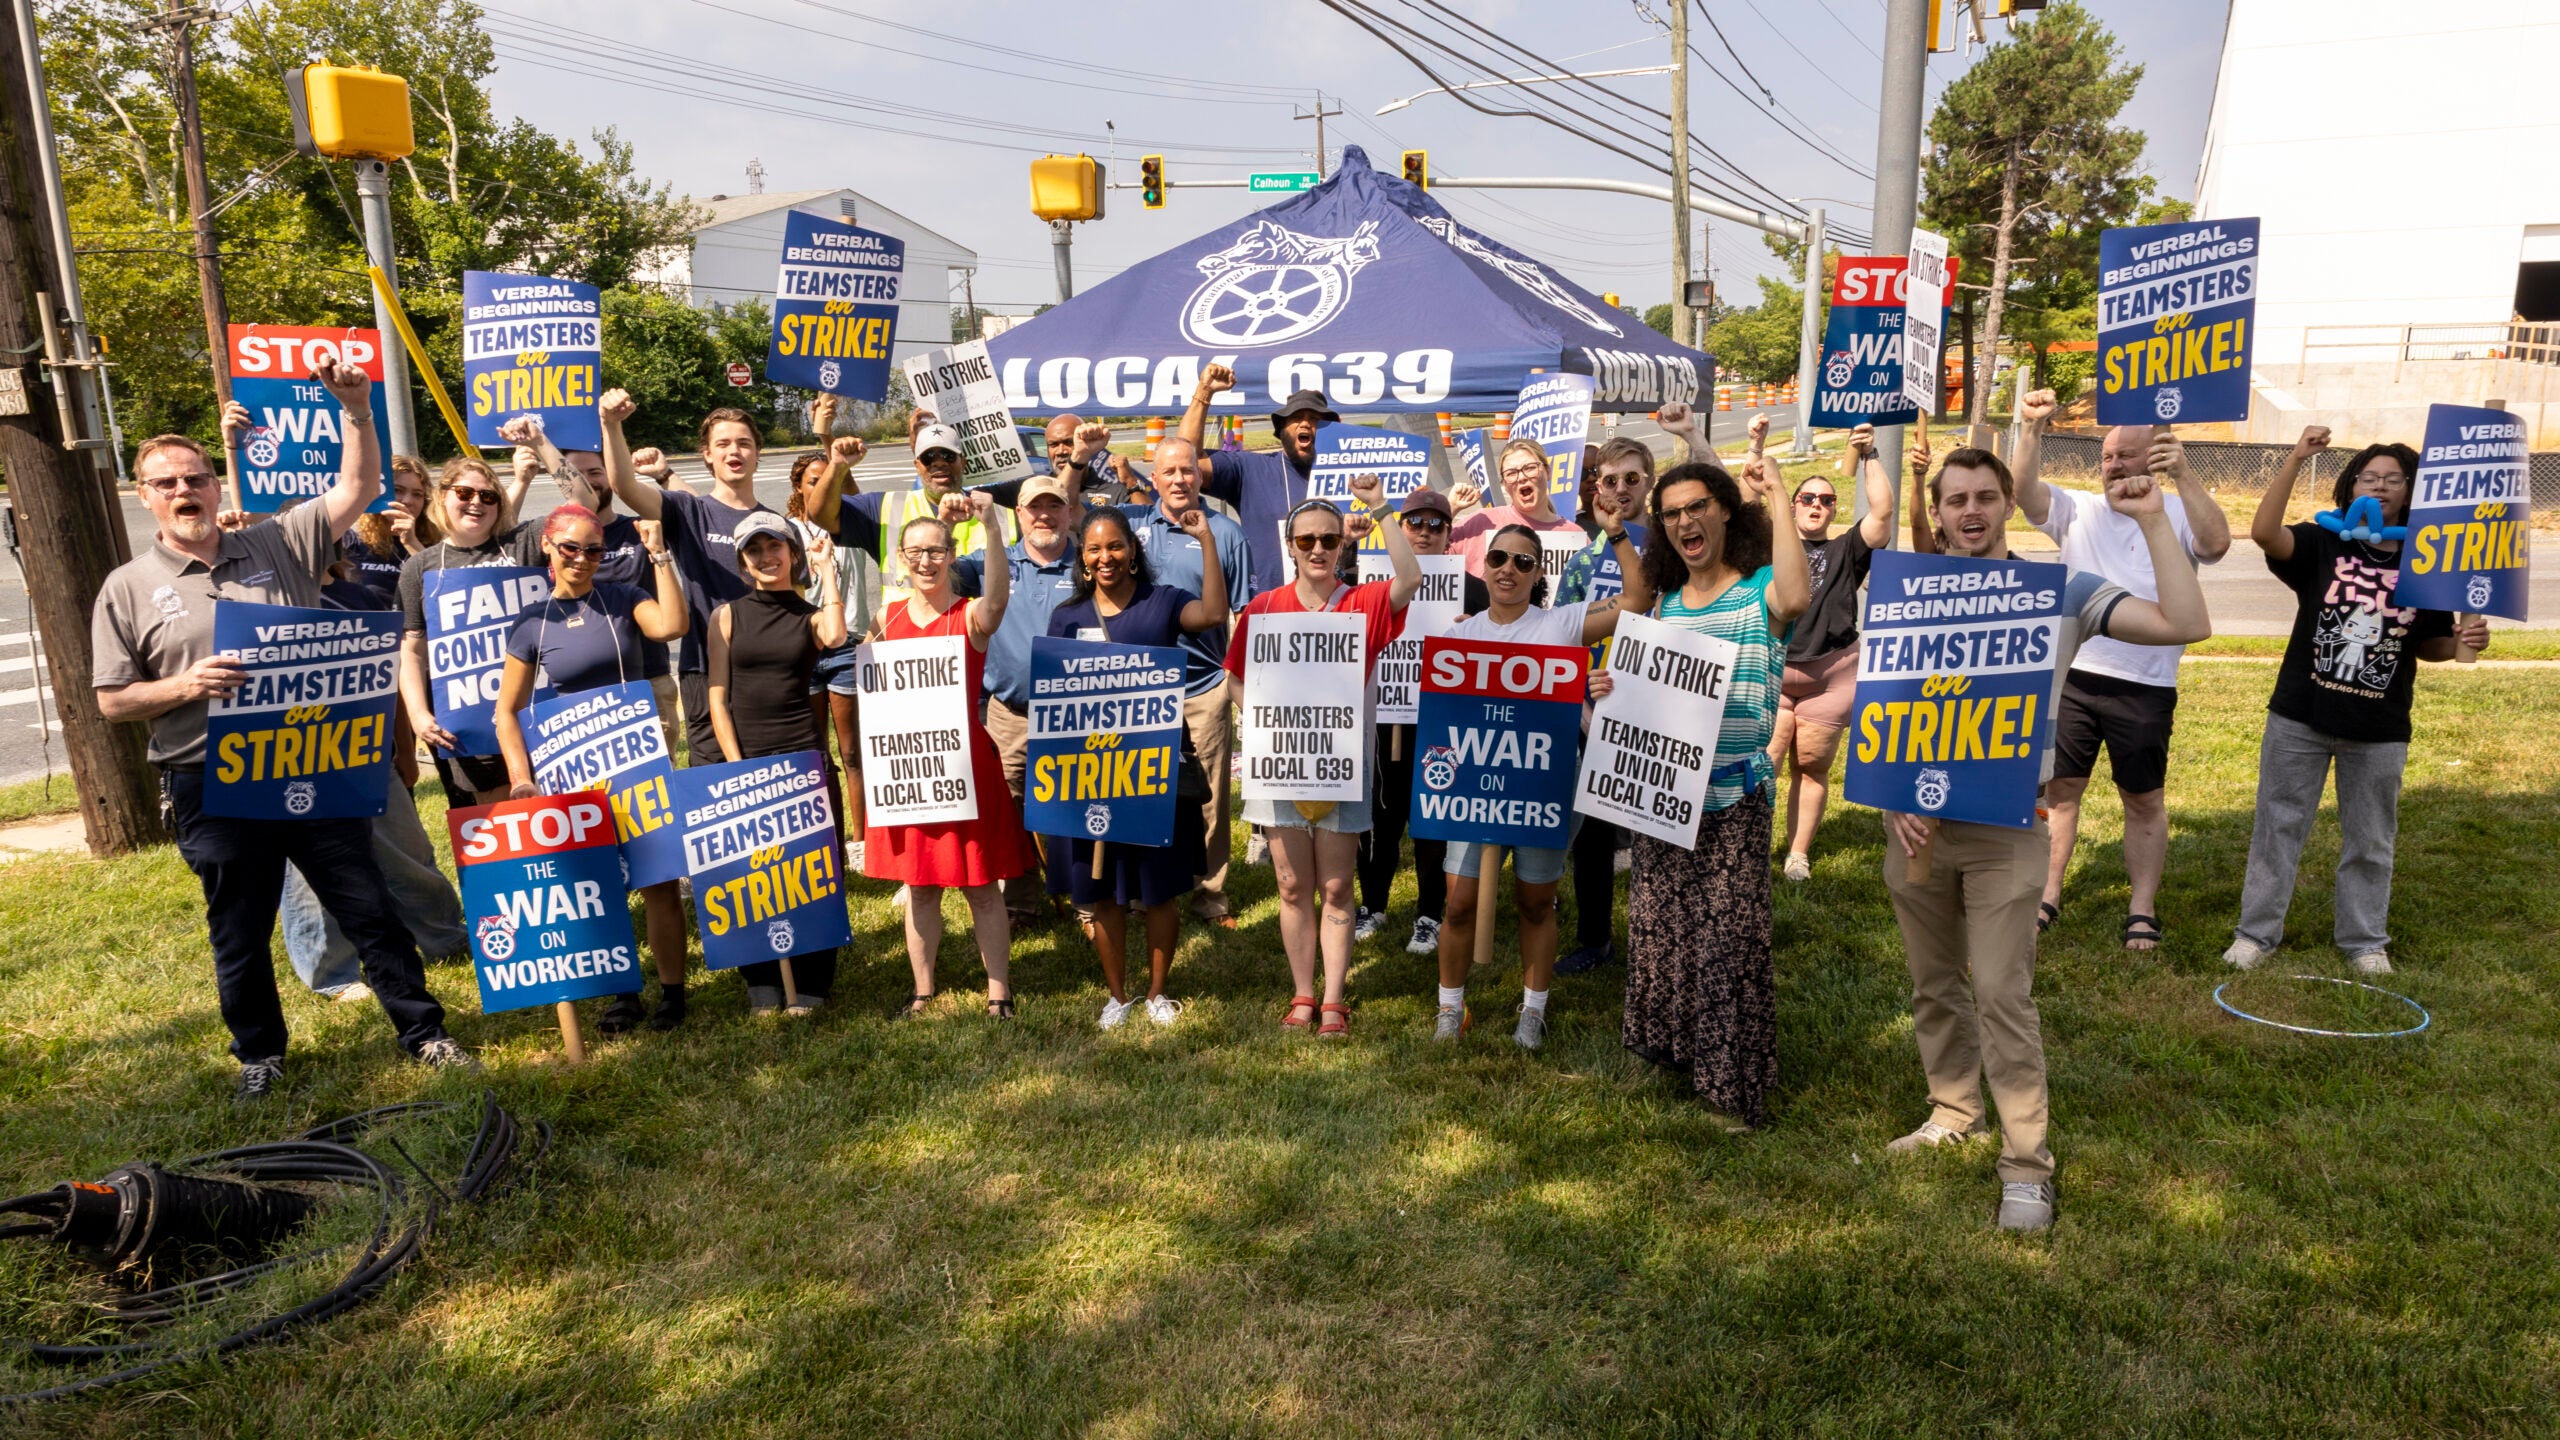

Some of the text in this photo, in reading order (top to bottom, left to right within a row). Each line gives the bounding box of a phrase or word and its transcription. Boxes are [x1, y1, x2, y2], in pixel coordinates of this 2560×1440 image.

[1254, 178, 1290, 188] Calhoun
[812, 232, 884, 250] VERBAL
[2130, 226, 2227, 260] VERBAL
[787, 247, 900, 267] BEGINNINGS
[1910, 248, 1943, 288] ON STRIKE
[2104, 237, 2254, 286] BEGINNINGS
[492, 285, 574, 301] VERBAL
[785, 270, 897, 300] TEAMSTERS
[1841, 267, 1950, 301] ST
[2104, 265, 2252, 325] TEAMSTERS
[469, 300, 596, 320] BEGINNINGS
[824, 299, 855, 315] on
[1878, 312, 1902, 328] THE
[470, 322, 596, 354] TEAMSTERS
[778, 314, 891, 360] STRIKE!
[1907, 315, 1937, 349] TEAMSTERS
[2154, 311, 2193, 335] on
[238, 336, 374, 373] STOP
[515, 350, 550, 367] on
[1850, 333, 1904, 366] WA
[2104, 318, 2245, 394] STRIKE!
[473, 365, 593, 416] STRIKE!
[913, 355, 992, 397] ON STRIKE
[1003, 348, 1454, 407] LOCAL 639
[1519, 378, 1569, 403] ERBAL
[1581, 346, 1699, 405] LOCAL 639
[1869, 371, 1889, 386] ON
[292, 385, 324, 402] THE
[262, 407, 344, 444] WA
[950, 411, 1007, 439] MSTERS
[302, 449, 327, 466] ON
[1315, 451, 1426, 465] BEGINNINGS
[1338, 437, 1408, 450] VERBAL
[963, 456, 993, 475] CAL
[994, 448, 1021, 467] 639
[246, 470, 386, 496] WORKS
[1314, 471, 1422, 497] TEATERS
[2474, 501, 2508, 520] on
[2411, 521, 2529, 575] STRIKE!
[1911, 569, 2022, 596] VERBAL
[1869, 589, 2056, 622] BEGINNINGS
[255, 618, 369, 643] VERBAL
[220, 632, 397, 664] BEGINNINGS
[1063, 653, 1155, 674] VERBAL
[1254, 633, 1281, 664] ON
[1289, 633, 1359, 663] STRIKE
[1867, 625, 2050, 673] TEAMSTERS
[863, 656, 959, 693] ON STRIKE
[1035, 668, 1180, 694] BEGINNINGS
[1381, 662, 1422, 683] UNIO
[1430, 650, 1578, 695] STOP
[1614, 635, 1644, 675] ON
[1649, 645, 1725, 700] STRIKE
[1377, 685, 1412, 706] CAL
[1921, 673, 1972, 698] on
[284, 703, 331, 725] on
[537, 691, 621, 737] VERBAL
[1035, 694, 1177, 733] TEAMSTERS
[1253, 705, 1354, 729] TEAMSTERS
[1483, 703, 1515, 723] THE
[532, 698, 651, 765] BEGINNINGS
[869, 728, 961, 757] TEAMSTERS
[1085, 731, 1123, 751] on
[1272, 731, 1333, 755] UNION
[1600, 716, 1703, 771] TEAMSTERS
[1857, 694, 2037, 764] STRIKE!
[216, 713, 386, 784] STRIKE!
[539, 725, 659, 796] TEAMSTERS
[1448, 725, 1552, 771] WAR
[708, 760, 797, 799] VERBAL
[890, 755, 945, 781] UNION
[1034, 746, 1171, 802] STRIKE!
[1251, 757, 1353, 781] LOCAL 639
[1480, 774, 1505, 791] ON
[1614, 750, 1677, 792] UNION
[685, 769, 821, 827] BEGINNINGS
[874, 778, 967, 807] LOCAL 639
[1587, 770, 1693, 825] LOCAL 639
[1419, 793, 1561, 828] WORKERS
[460, 803, 603, 858] STOP
[691, 795, 827, 866] TEAMSTERS
[523, 860, 557, 880] THE
[750, 844, 785, 870] on
[494, 880, 605, 929] WAR
[704, 845, 837, 936] STRIKE!
[540, 930, 566, 949] ON
[483, 945, 631, 992] WORKERS
